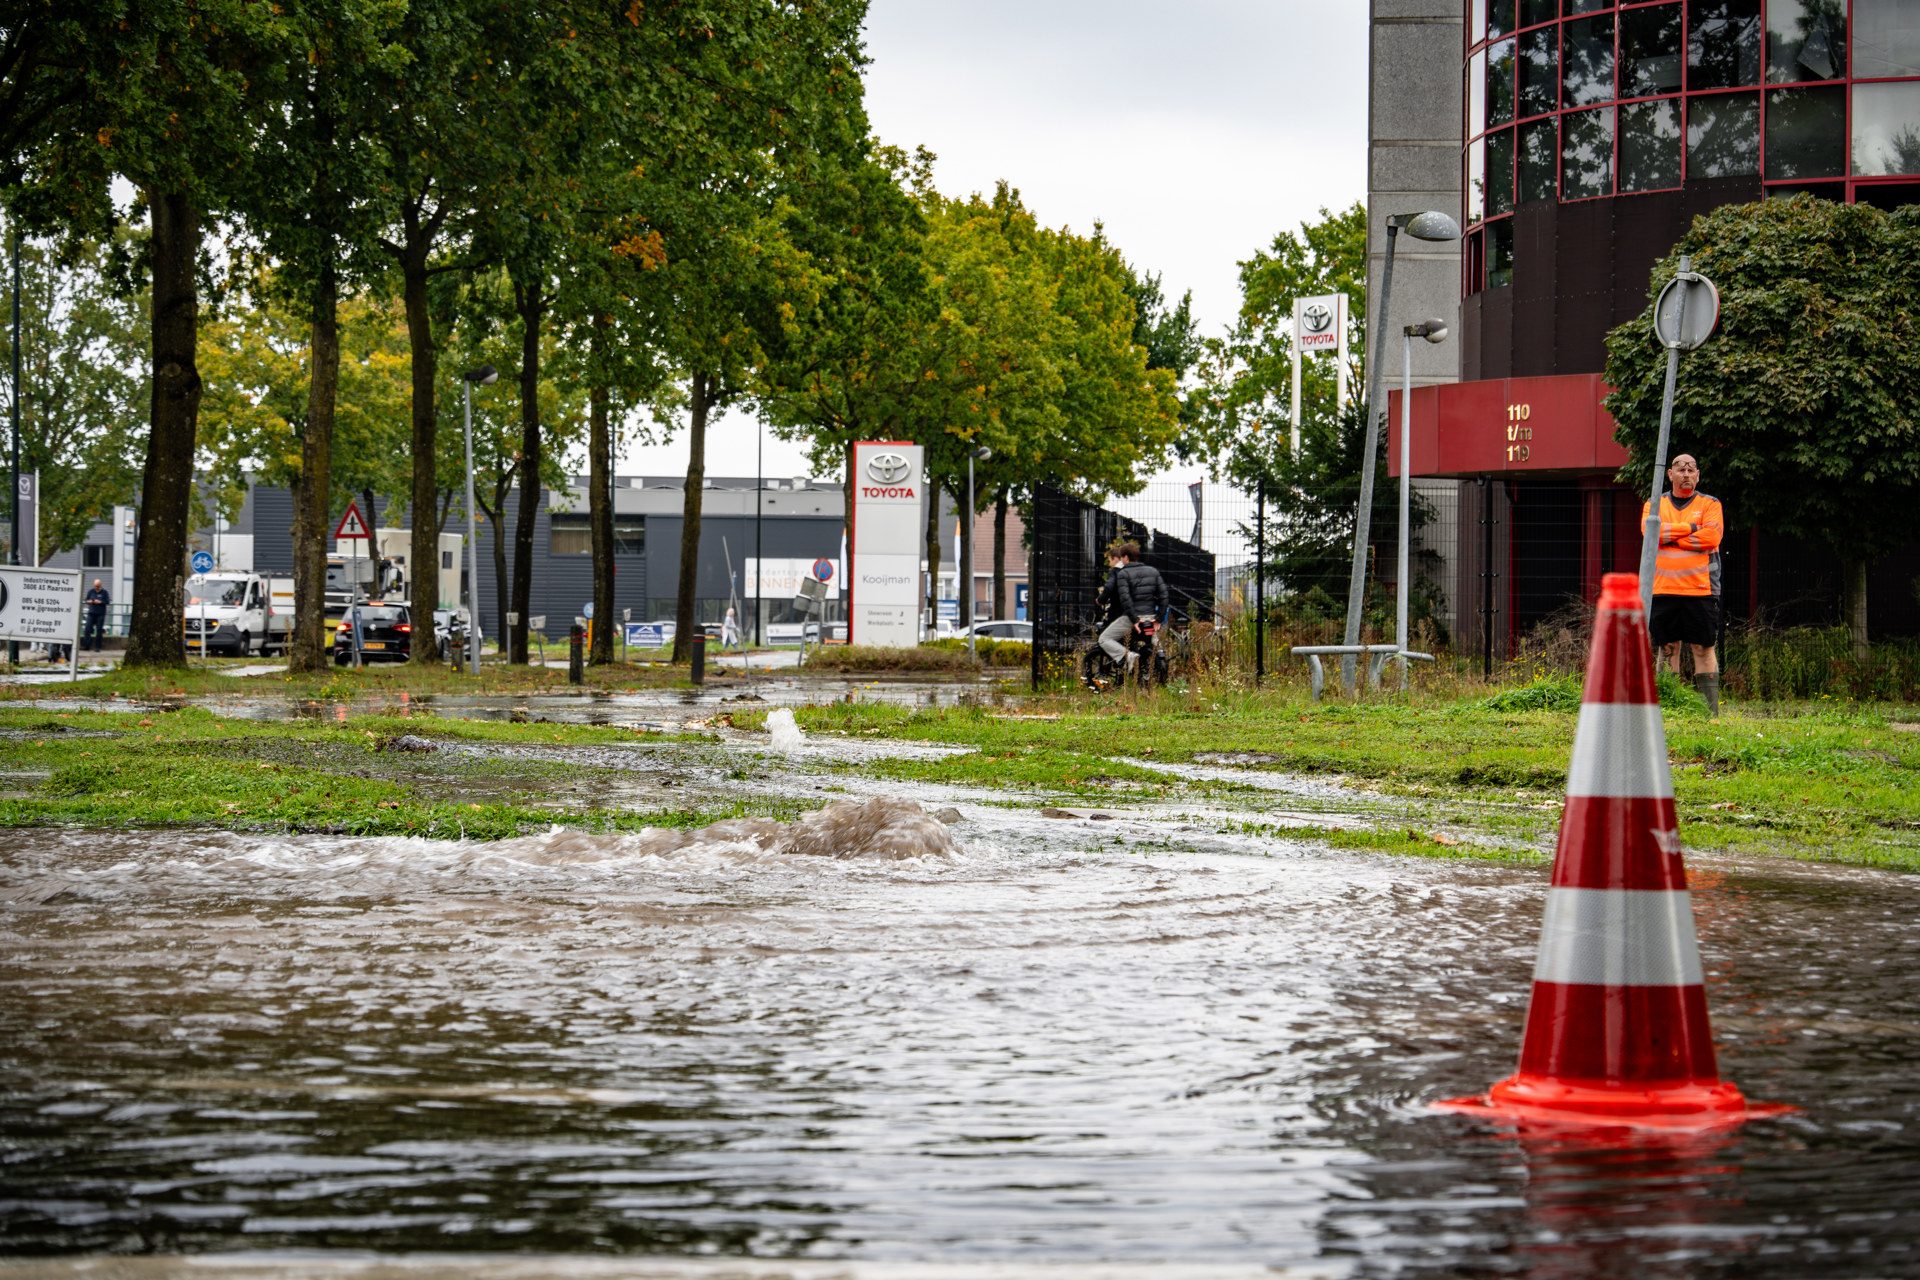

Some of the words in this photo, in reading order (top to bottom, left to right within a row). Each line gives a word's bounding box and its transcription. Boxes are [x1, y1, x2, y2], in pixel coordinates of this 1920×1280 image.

[1301, 334, 1335, 346] TOYOTA
[1507, 404, 1531, 421] 110
[1507, 424, 1533, 442] t/m
[1506, 445, 1530, 462] 119
[862, 487, 915, 499] TOYOTA
[23, 577, 60, 586] Industrieweg
[862, 575, 911, 586] Kooijman
[36, 619, 53, 627] Group
